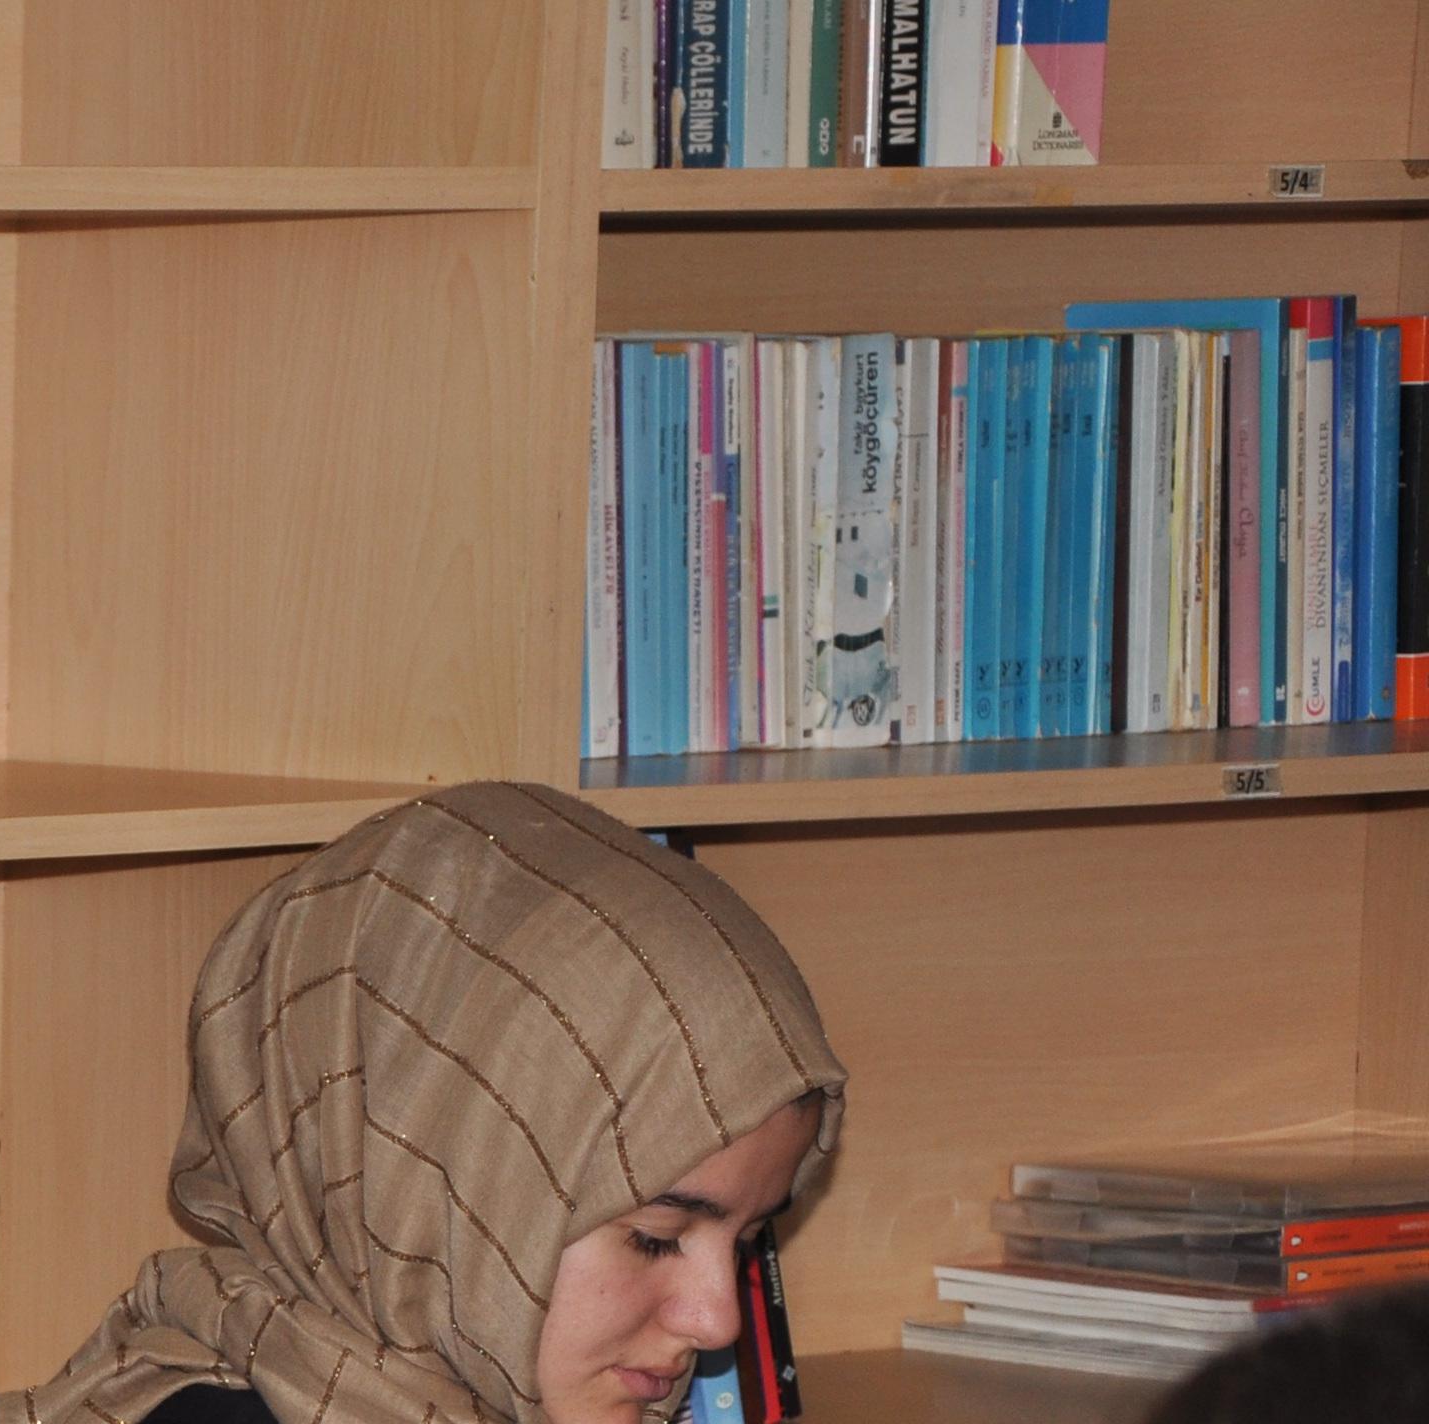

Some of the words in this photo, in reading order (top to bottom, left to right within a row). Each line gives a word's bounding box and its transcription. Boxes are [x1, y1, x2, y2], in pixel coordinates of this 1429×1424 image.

[683, 40, 722, 155] ÇÖLLERİNDE
[883, 0, 923, 145] MALHATUN
[1279, 168, 1309, 196] 5/4
[861, 351, 881, 494] köygöçüren
[1318, 420, 1331, 505] SEÇMELER
[1236, 769, 1265, 794] 5/5
